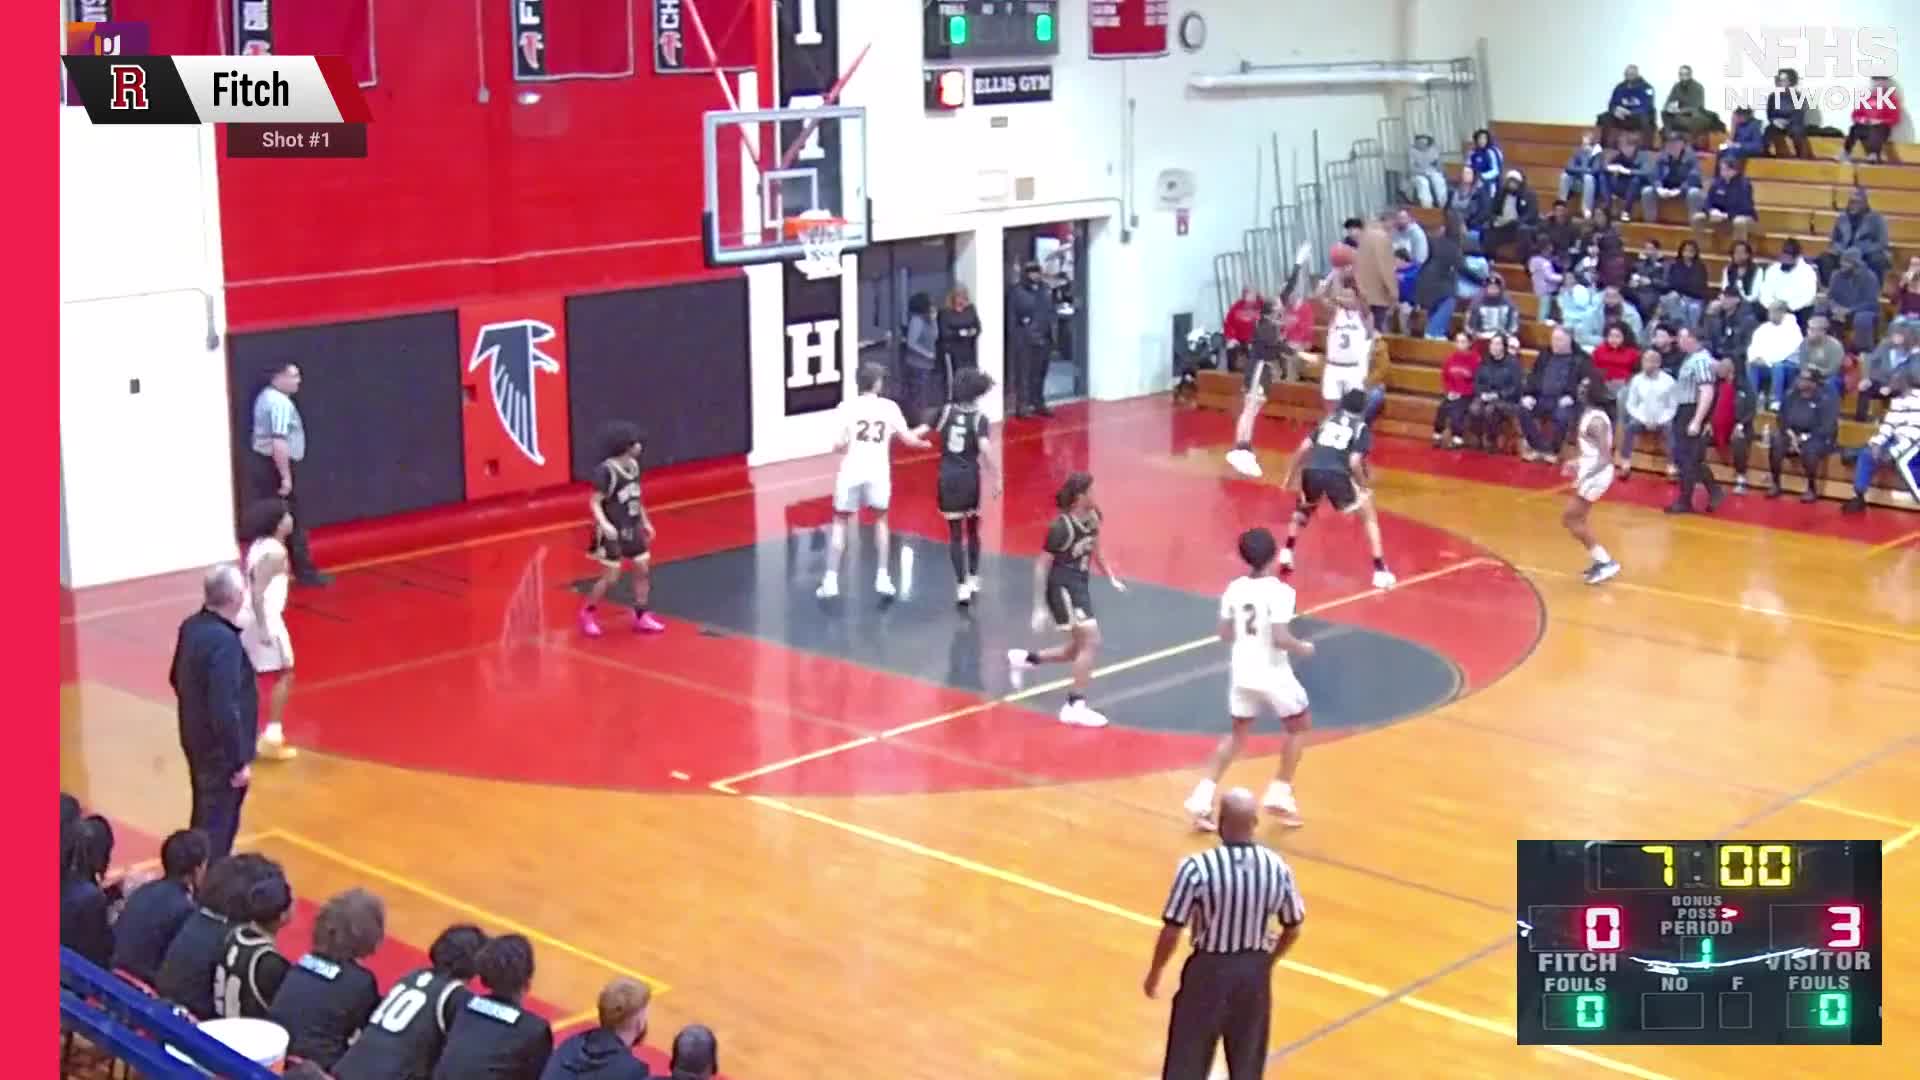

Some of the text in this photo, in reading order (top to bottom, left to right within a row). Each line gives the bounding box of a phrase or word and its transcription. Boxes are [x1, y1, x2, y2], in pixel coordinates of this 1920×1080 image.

[974, 76, 1016, 95] ELLIS
[1018, 75, 1050, 92] GYM
[1338, 333, 1351, 350] 3
[856, 420, 886, 444] 23
[1242, 603, 1258, 636] 2
[1671, 896, 1723, 907] BONUS
[1678, 908, 1717, 919] POSS
[1585, 907, 1621, 951] 0
[1660, 921, 1734, 936] PERIOD
[1827, 906, 1862, 949] 3
[1538, 953, 1618, 973] FITCH
[1766, 951, 1872, 971] VISITOR
[1544, 977, 1608, 992] FOULS
[1661, 976, 1689, 991] NO
[1732, 976, 1744, 991] F
[1789, 976, 1850, 990] FOULS
[369, 982, 427, 1033] 10
[1576, 995, 1604, 1028] 0
[1819, 994, 1848, 1026] 0
